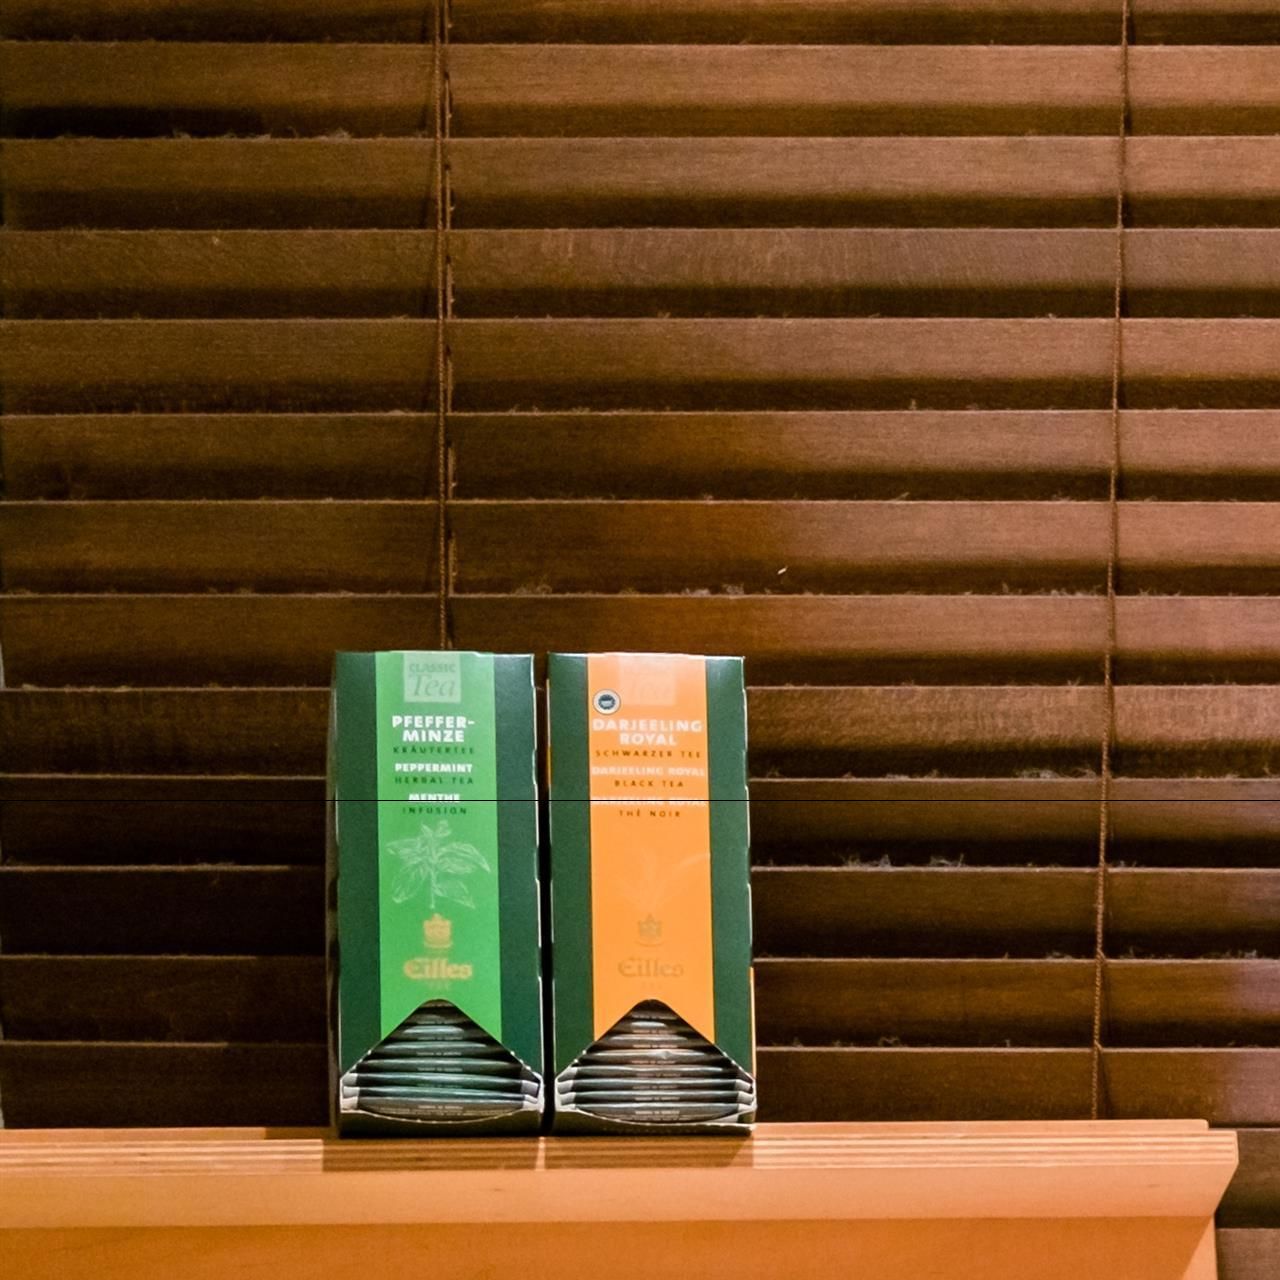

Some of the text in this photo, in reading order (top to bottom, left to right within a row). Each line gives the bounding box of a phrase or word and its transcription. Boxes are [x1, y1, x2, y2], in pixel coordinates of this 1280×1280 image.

[409, 663, 456, 674] CLASSIC
[412, 673, 456, 697] Tea
[391, 715, 476, 729] PFEFFER-
[592, 719, 703, 733] DARJEELING
[402, 729, 465, 743] MINZE
[619, 732, 677, 746] ROYAL
[393, 746, 475, 755] KRÄUTERTEE
[596, 750, 701, 759] SCHWARZER TEE
[395, 763, 473, 773] PEPPERMINT
[591, 766, 705, 777] DARJEELING ROYAL
[395, 777, 443, 785] HERBAL
[614, 779, 654, 787] BLACK
[408, 793, 461, 803] MENTHE
[402, 806, 468, 815] INFUSION
[649, 810, 681, 818] NOIR
